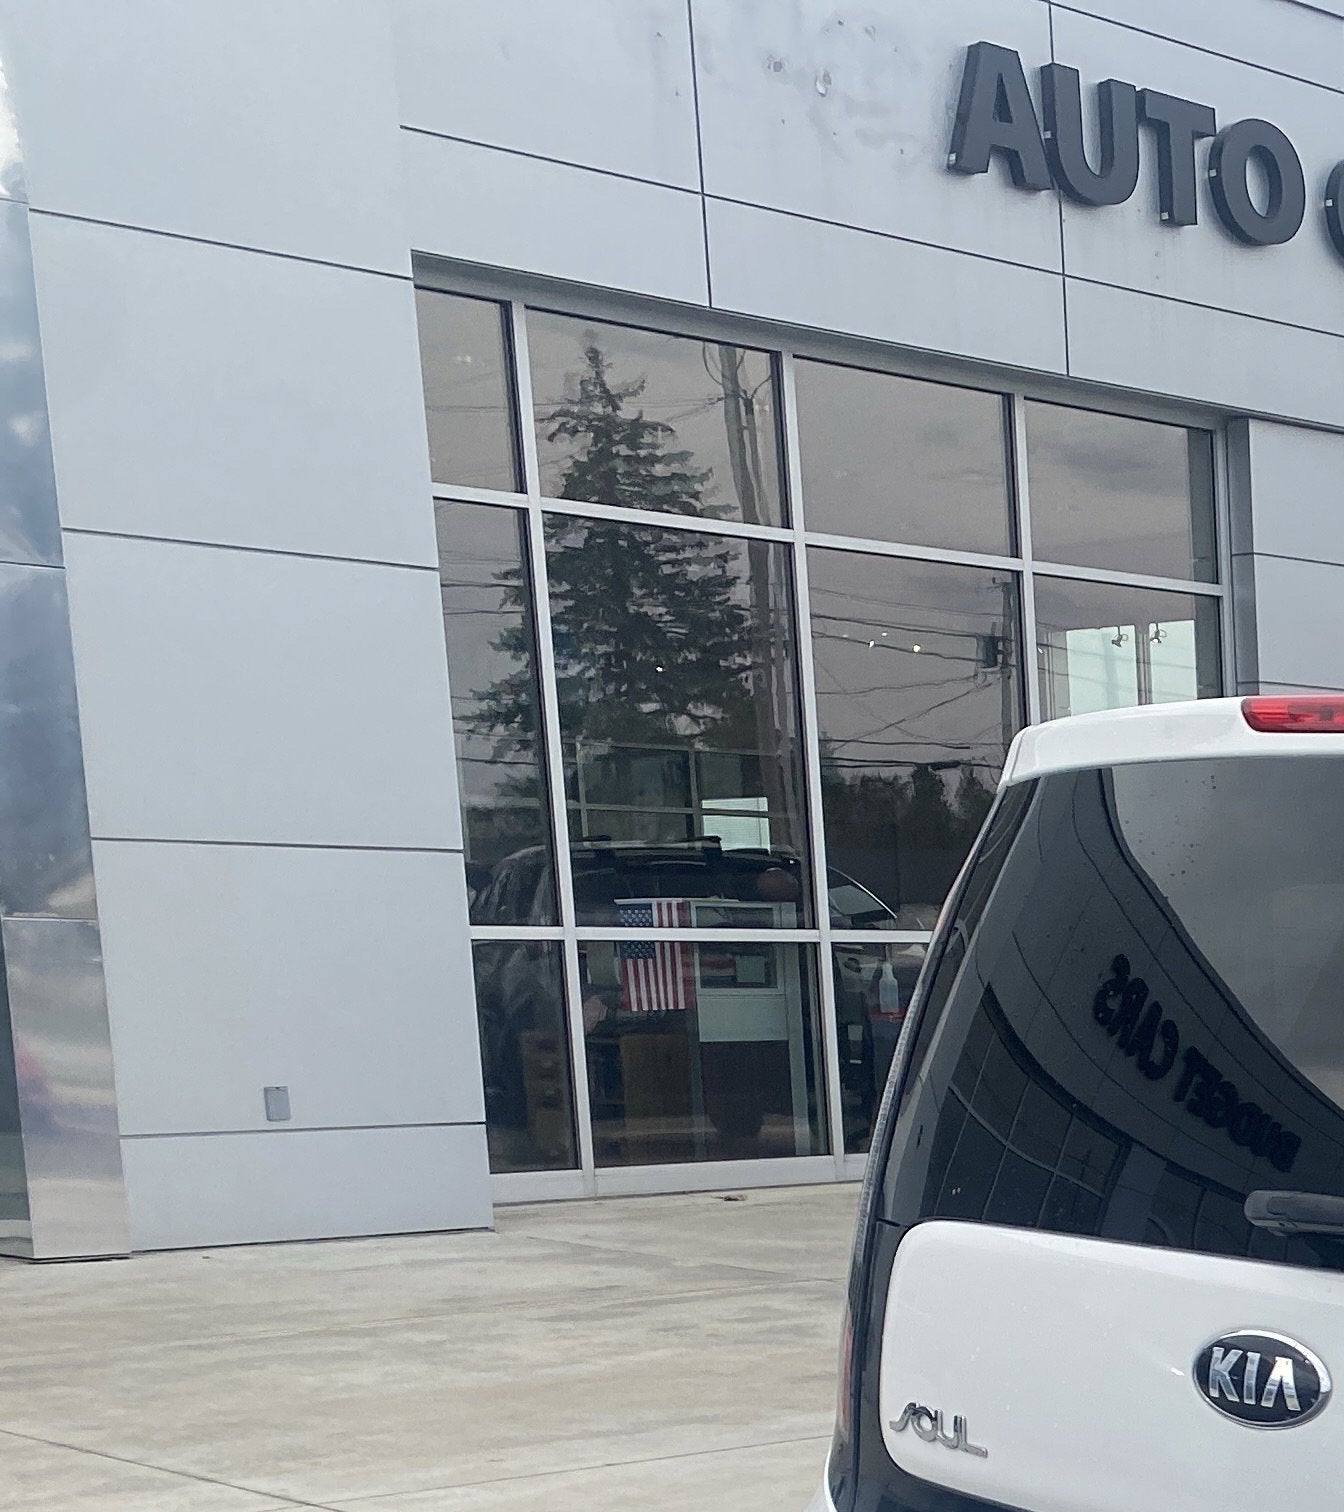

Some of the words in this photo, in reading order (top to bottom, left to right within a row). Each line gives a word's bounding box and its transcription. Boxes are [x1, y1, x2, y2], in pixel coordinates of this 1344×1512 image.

[947, 40, 1307, 246] AUTO
[1208, 1345, 1302, 1412] KIA
[889, 1401, 988, 1458] SOUL
